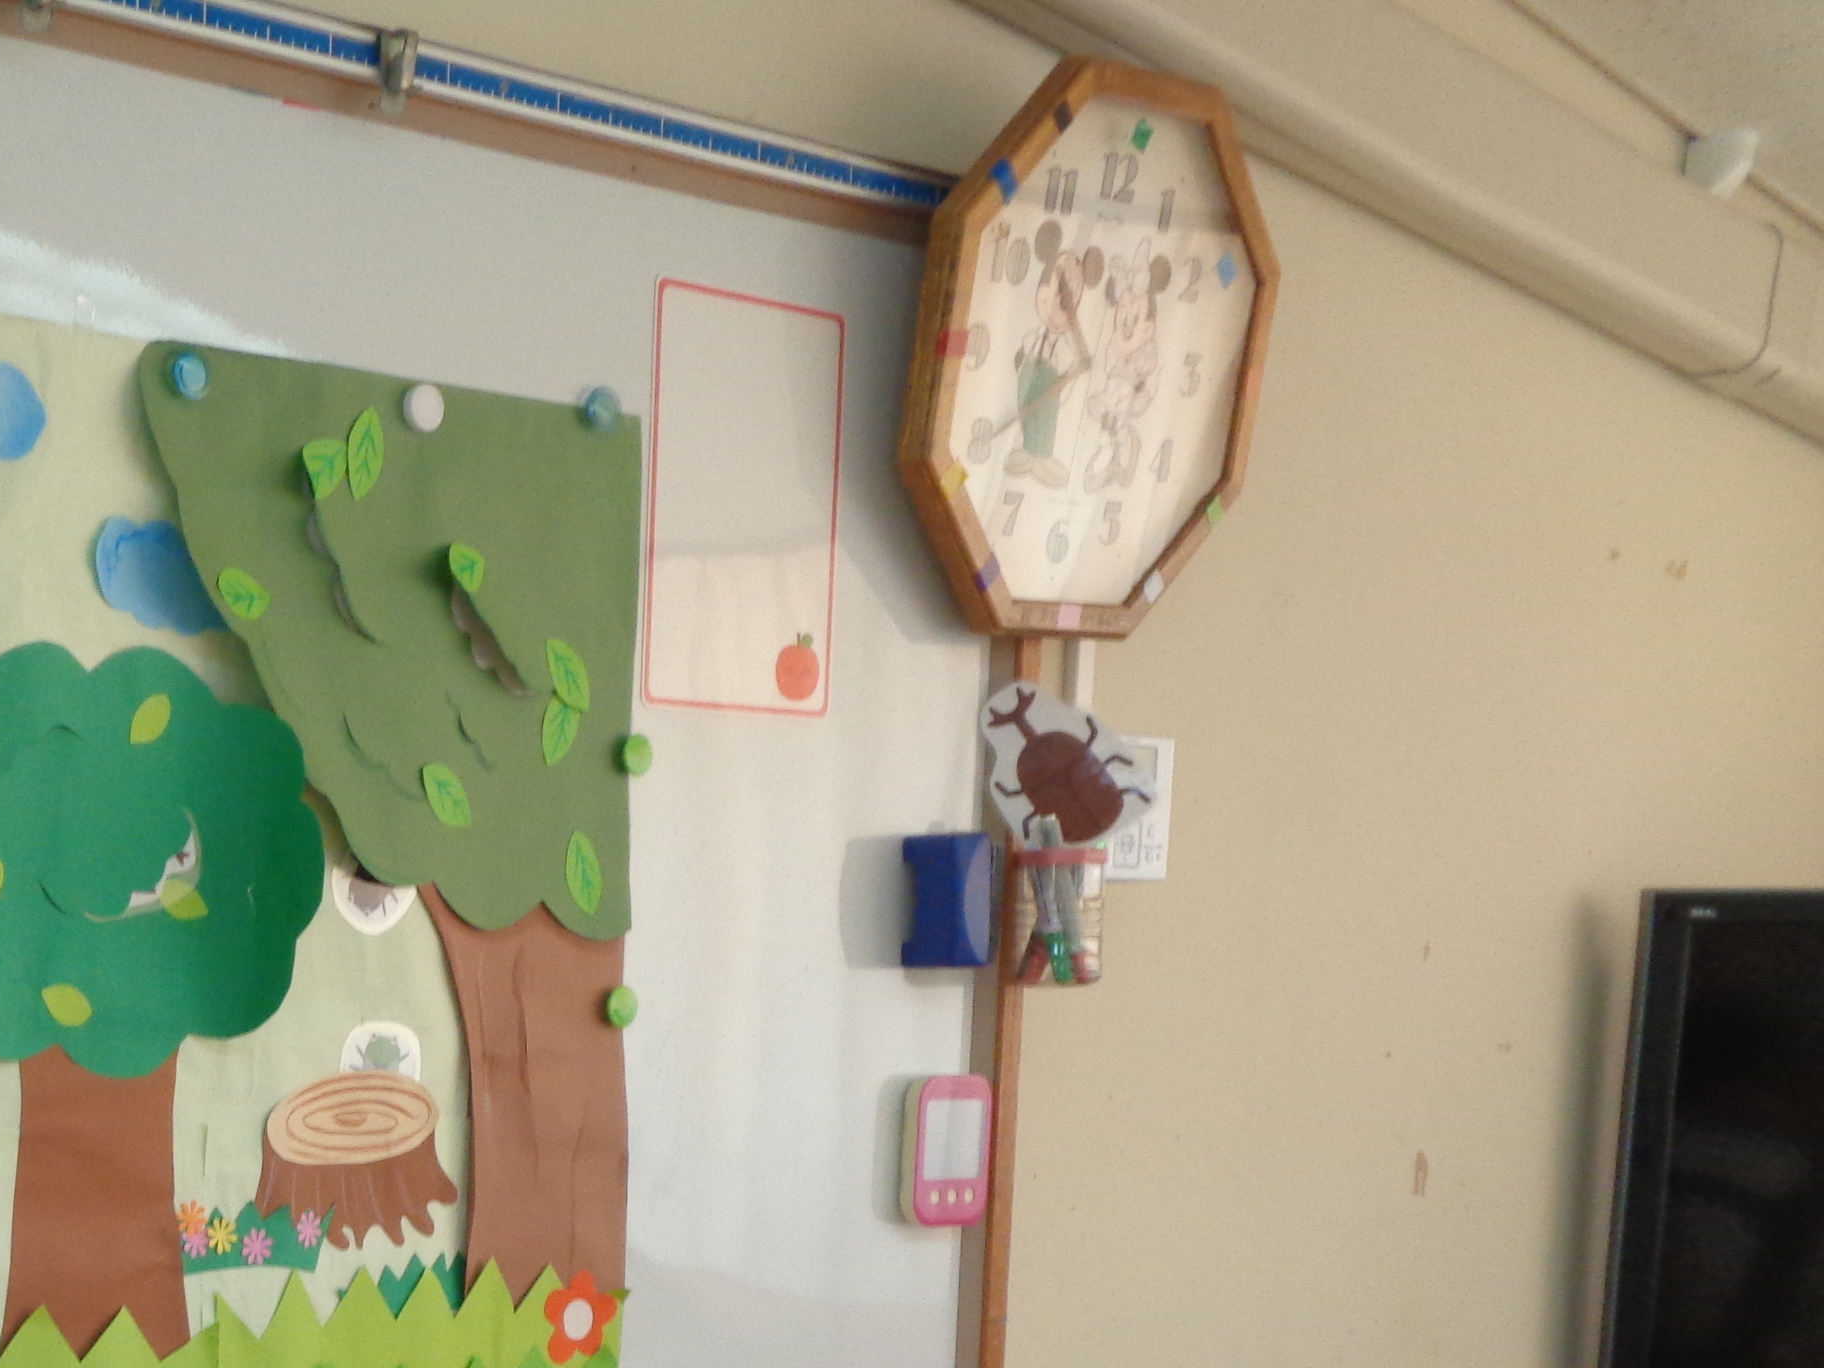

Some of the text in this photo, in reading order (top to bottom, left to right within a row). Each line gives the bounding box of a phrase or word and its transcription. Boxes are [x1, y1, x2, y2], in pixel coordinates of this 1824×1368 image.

[1044, 167, 1079, 216] 11
[1100, 153, 1139, 204] 12
[1157, 188, 1176, 234] 1
[990, 235, 1032, 287] 10
[1178, 256, 1203, 303] 2
[1179, 352, 1202, 398] 3
[967, 418, 994, 466] 8
[1149, 438, 1174, 484] 4
[1002, 490, 1026, 538] 7
[1099, 501, 1123, 547] 5
[1046, 516, 1071, 565] 6
